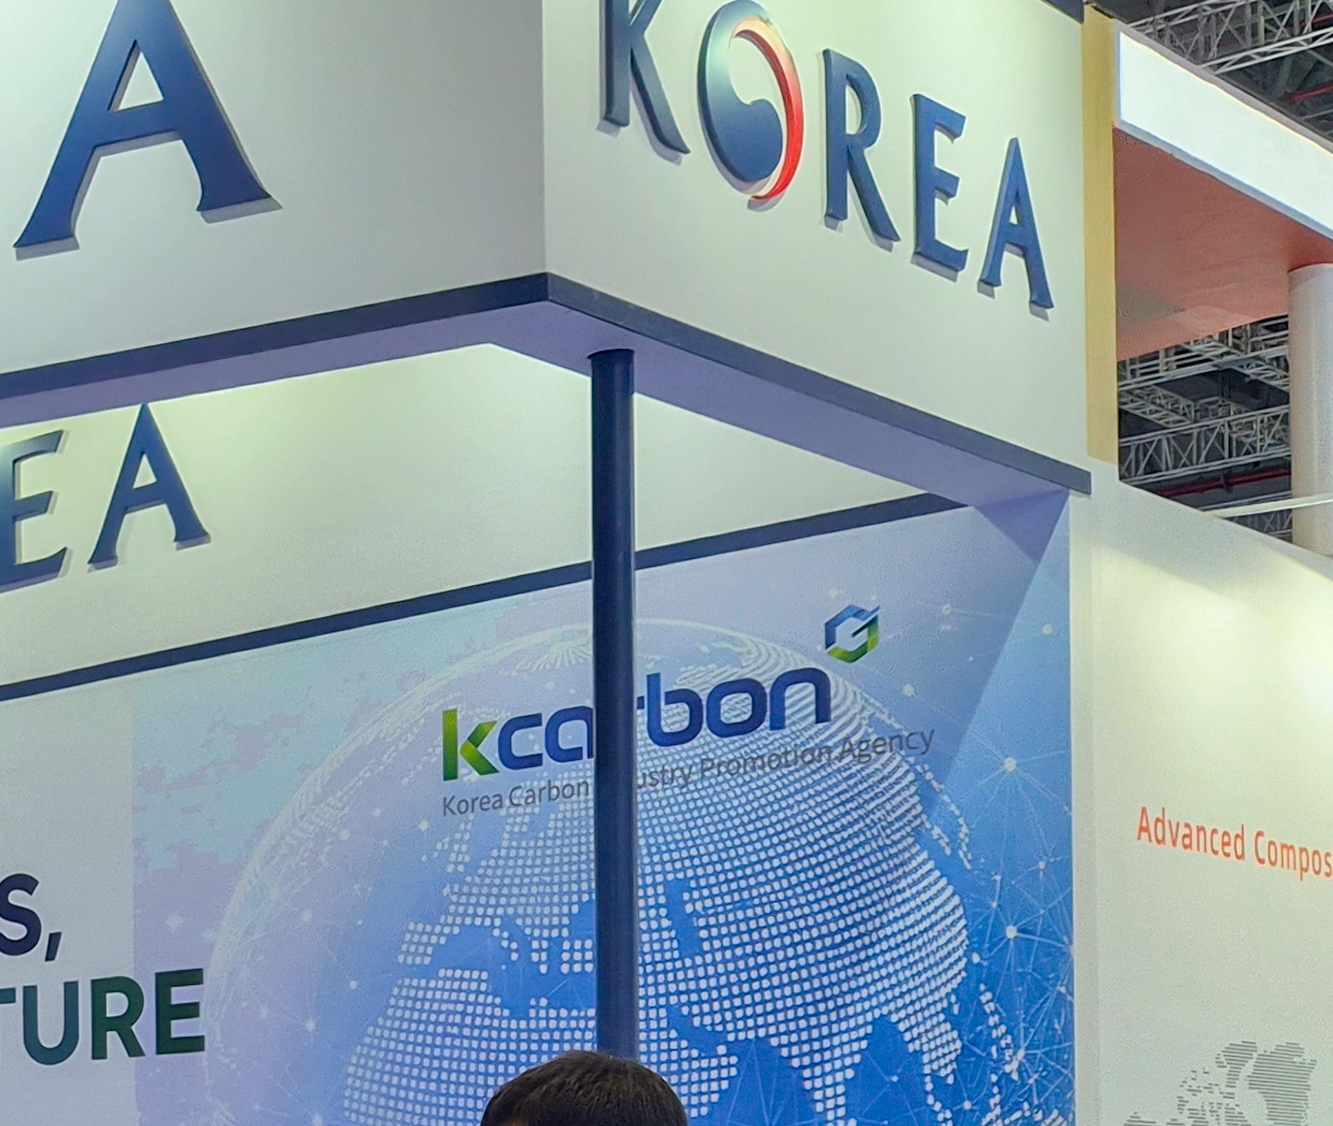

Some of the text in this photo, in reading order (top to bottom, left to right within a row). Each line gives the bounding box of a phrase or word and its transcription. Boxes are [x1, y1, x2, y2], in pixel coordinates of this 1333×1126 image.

[601, 0, 1055, 310] KOREA
[442, 667, 832, 782] kcabon
[443, 792, 504, 817] Korea
[508, 779, 590, 807] Carbon
[700, 744, 833, 778] Promotion
[840, 728, 935, 764] Agency
[1136, 806, 1333, 881] Advanced Compos
